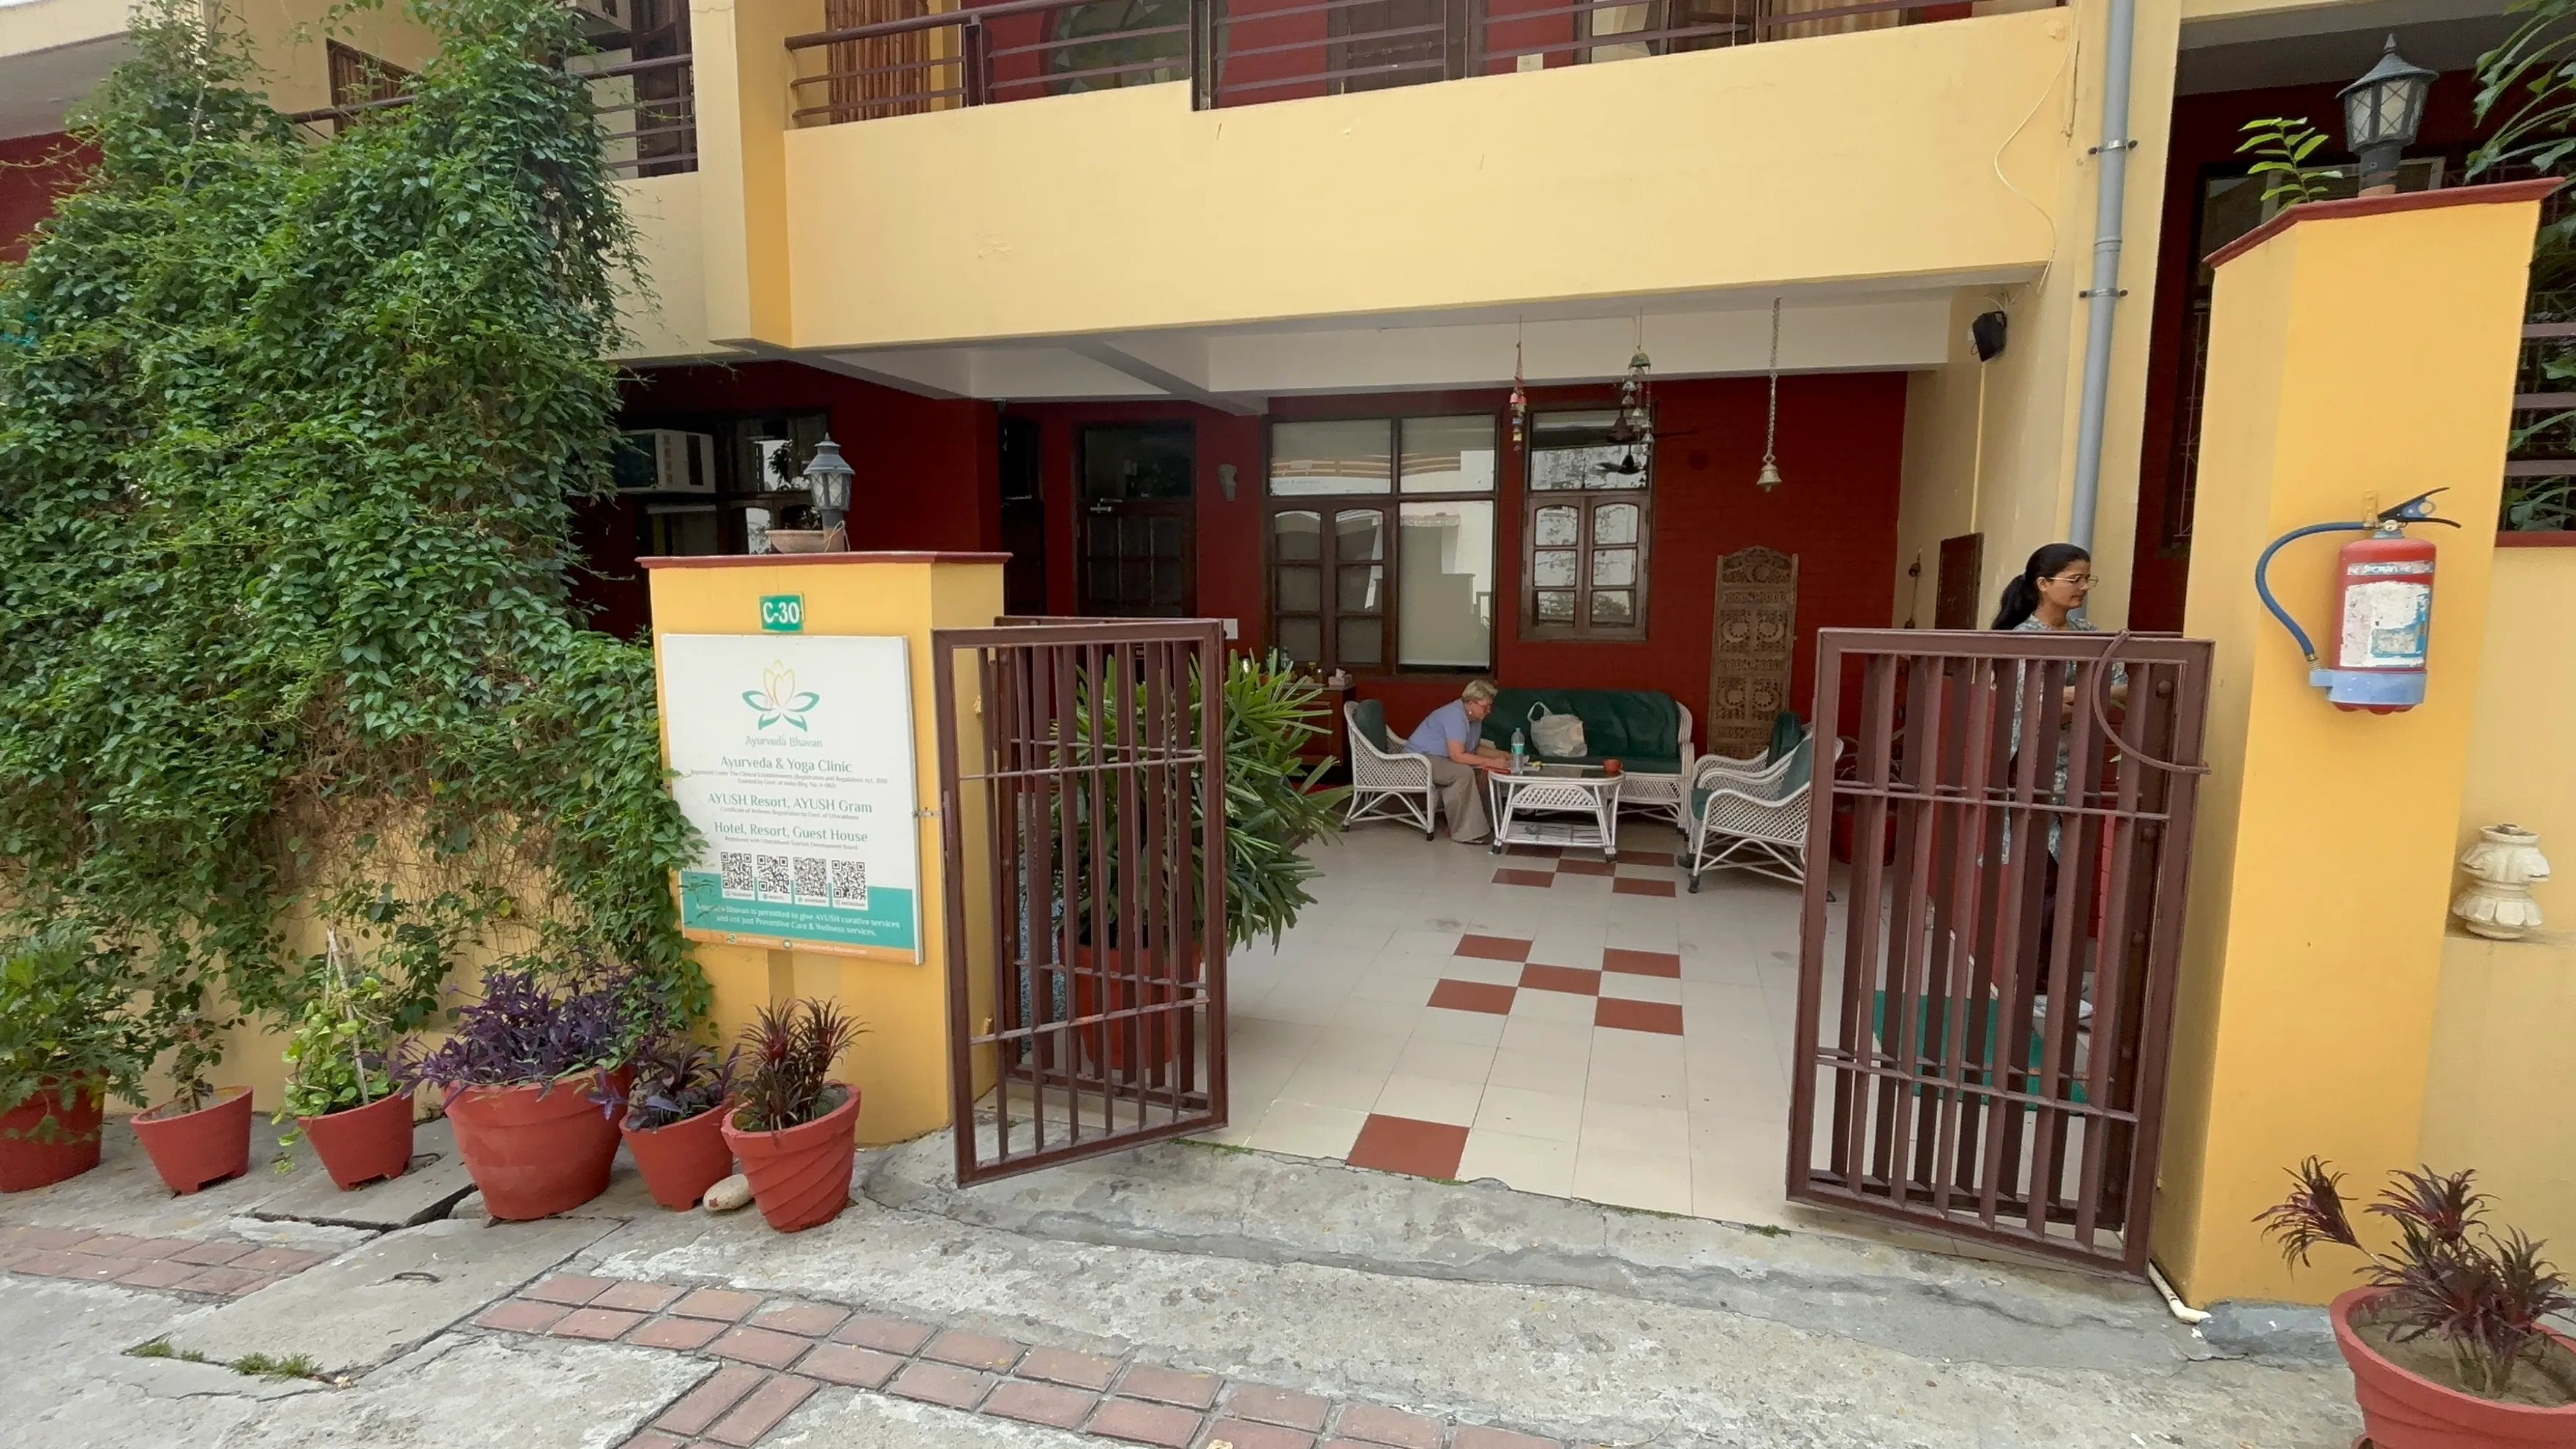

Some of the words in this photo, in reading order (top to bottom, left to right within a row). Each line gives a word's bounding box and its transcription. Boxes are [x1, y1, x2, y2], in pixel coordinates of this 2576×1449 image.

[763, 602, 801, 624] C-30
[789, 735, 823, 748] Bhavan
[721, 755, 773, 771] Ayurveda
[776, 757, 785, 769] &
[787, 757, 815, 774] Yoga
[818, 759, 853, 773] Clinic
[708, 793, 747, 805] AYUSH
[750, 795, 790, 809] Resort,
[793, 798, 835, 810] AYUSH
[839, 799, 872, 812] Gram
[714, 821, 746, 835] Hotel,
[750, 823, 790, 838] Resort,
[793, 825, 827, 839] Guest
[831, 828, 868, 842] House
[755, 918, 790, 928] Preventive
[791, 921, 807, 929] Care
[758, 910, 790, 918] permitted
[815, 913, 839, 923] AYUSH
[841, 916, 869, 925] curative
